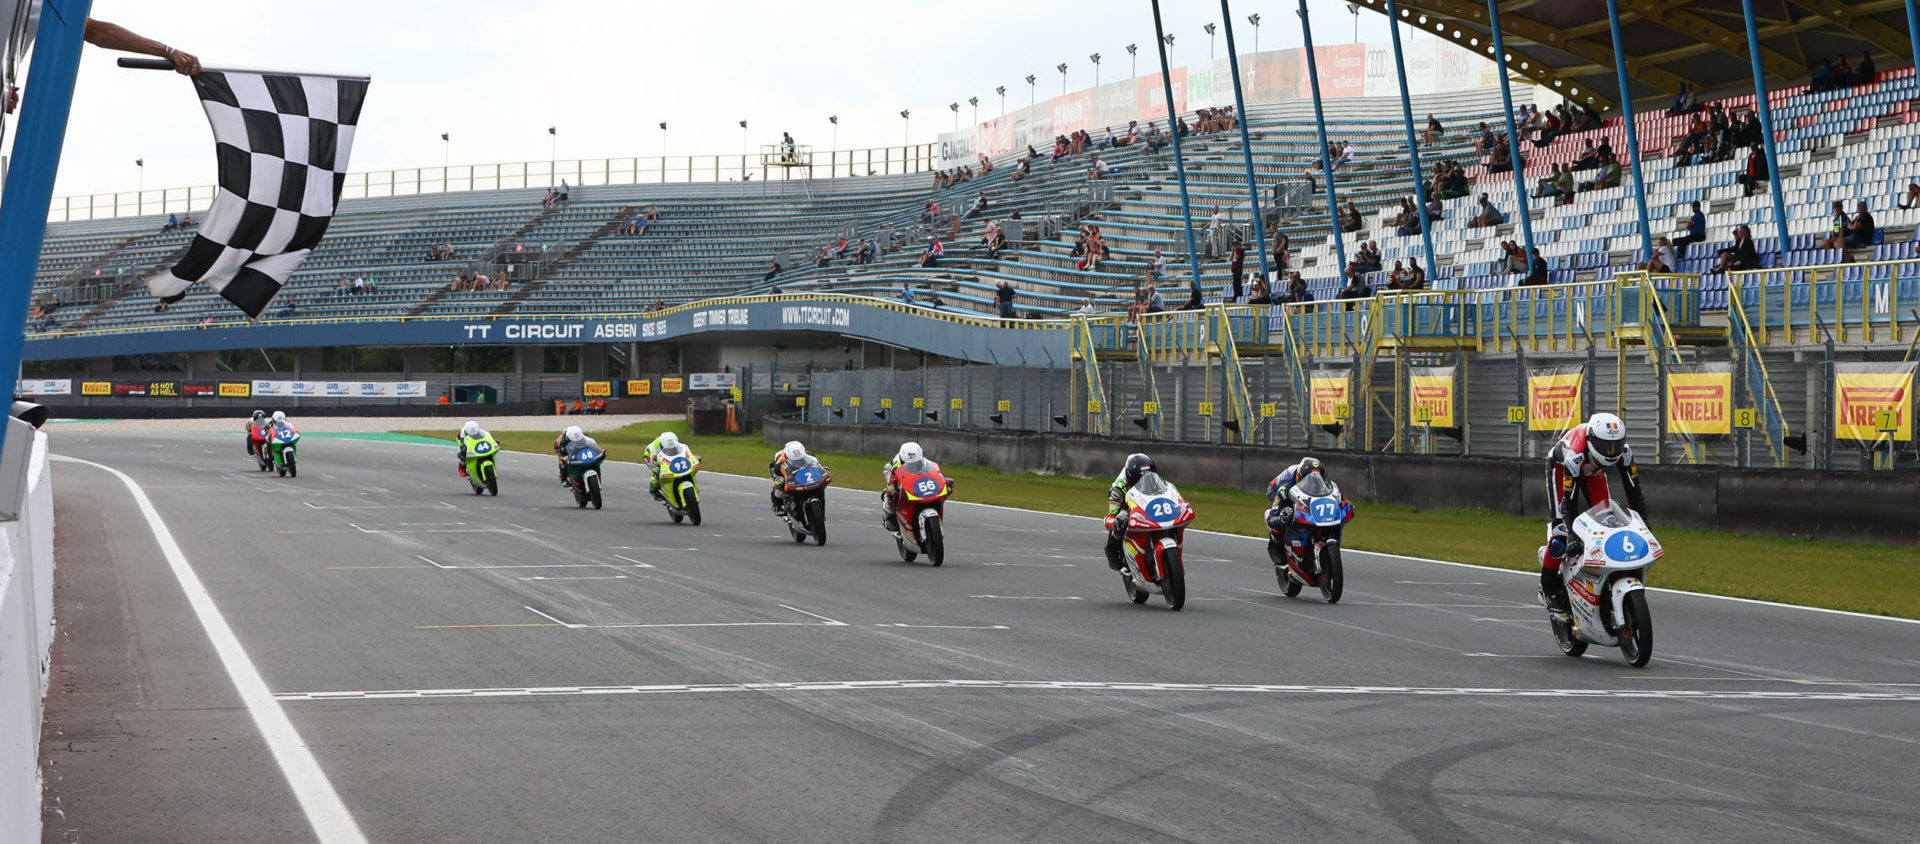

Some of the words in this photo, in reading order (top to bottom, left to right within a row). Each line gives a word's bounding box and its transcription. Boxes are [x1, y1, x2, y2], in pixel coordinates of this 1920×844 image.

[1875, 283, 1889, 314] M
[728, 308, 748, 325] TRIBUNE
[1576, 302, 1584, 327] N
[464, 325, 491, 338] TT
[505, 324, 584, 338] CIRCUIT
[594, 323, 636, 338] ASSEN
[642, 322, 654, 337] SINCE
[914, 398, 923, 407] 20
[953, 399, 960, 408] 19
[1000, 401, 1008, 410] 18
[1089, 402, 1099, 411] 16
[1313, 387, 1344, 415] PIREL
[1532, 385, 1577, 419] PIRELLI
[1672, 385, 1724, 421] PIRELLI
[1841, 387, 1904, 427] PIREI
[1145, 403, 1155, 413] 15
[1201, 404, 1211, 413] 14
[1263, 405, 1273, 416] 13
[1337, 406, 1347, 417] 12
[1419, 407, 1429, 419] 11
[1510, 408, 1524, 421] 10
[1741, 411, 1750, 426] 8
[1883, 413, 1890, 429] 7
[279, 430, 292, 439] 12
[581, 451, 593, 460] 68
[674, 460, 688, 471] 92
[805, 472, 814, 482] 2
[918, 480, 936, 493] 56
[1152, 502, 1173, 517] 28
[1315, 503, 1335, 517] 77
[1622, 535, 1635, 553] 6
